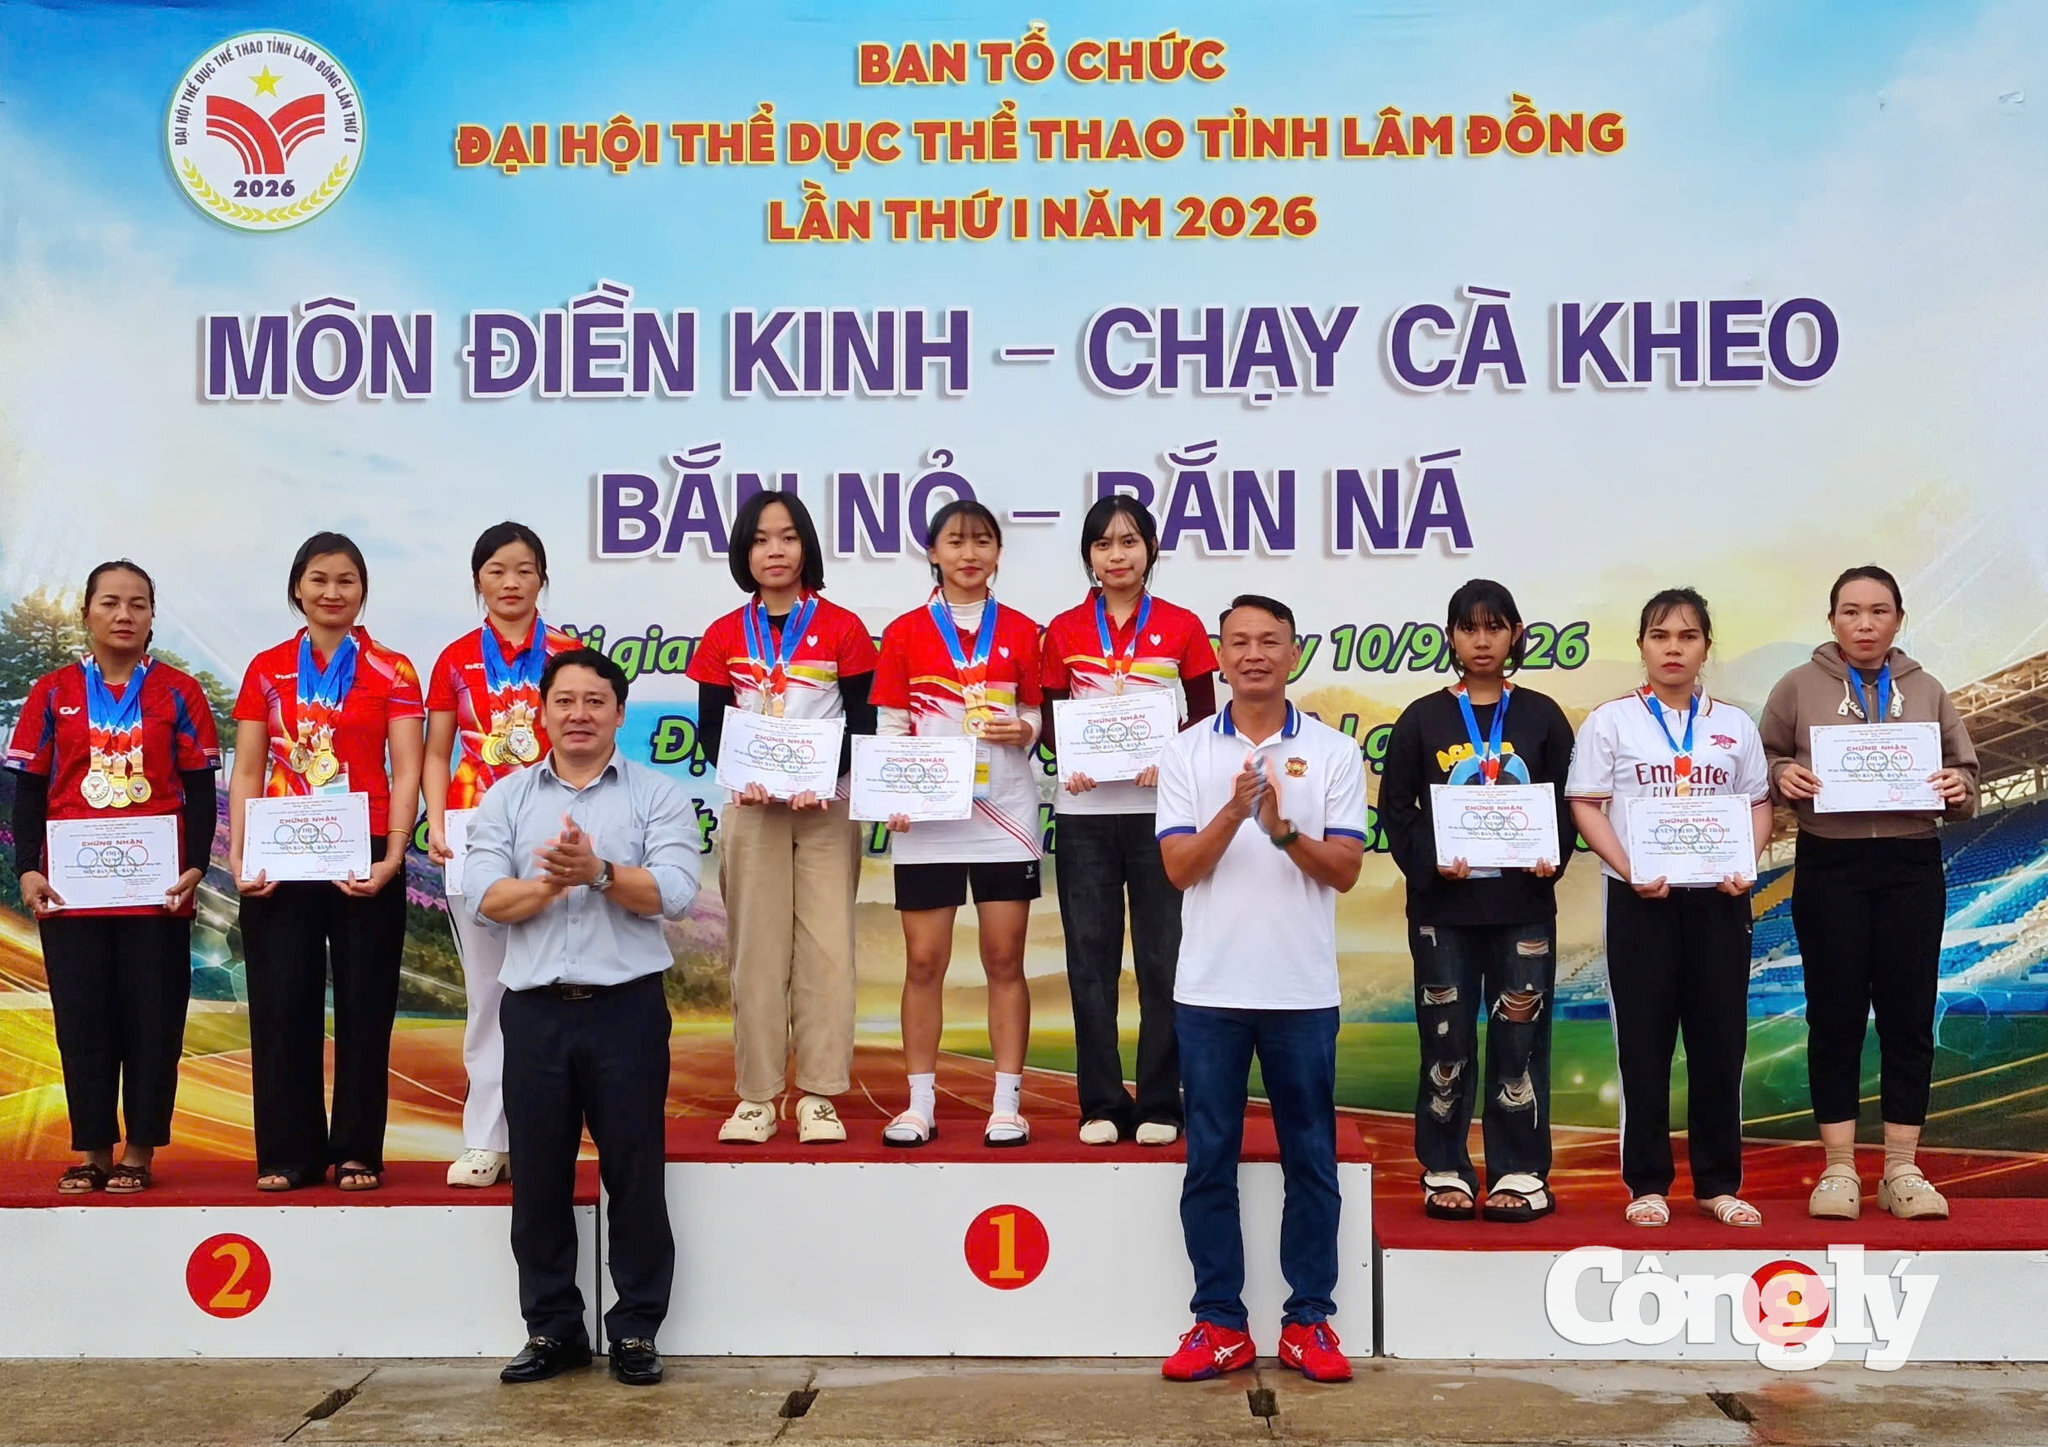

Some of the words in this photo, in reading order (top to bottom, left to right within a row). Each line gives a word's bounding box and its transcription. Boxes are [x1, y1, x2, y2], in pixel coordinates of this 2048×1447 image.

[194, 63, 216, 84] DỤC
[235, 41, 263, 57] THAO
[293, 45, 317, 66] LÂM
[861, 43, 967, 84] BAN
[980, 20, 1056, 83] TỔ
[1067, 31, 1226, 81] CHỨC
[175, 105, 192, 124] HỘI
[175, 127, 190, 145] ĐẠI
[457, 124, 547, 173] ĐẠI
[562, 115, 659, 173] HỘI
[673, 103, 776, 163] THỂ
[790, 121, 902, 171] DỤC
[914, 100, 1018, 161] THỂ
[1030, 119, 1185, 160] THAO
[1197, 107, 1329, 159] TỈNH
[1344, 107, 1454, 157] LÂM
[1466, 94, 1625, 156] ĐỒNG
[233, 179, 295, 197] 2026
[770, 180, 871, 241] LẦN
[885, 189, 1004, 240] THỨ
[1014, 197, 1029, 239] I
[1044, 189, 1162, 238] NĂM
[1178, 196, 1318, 238] 2026
[209, 296, 433, 397] MÔN
[467, 283, 695, 394] ĐIỀN
[734, 309, 969, 395] KINH
[1088, 306, 1360, 402] CHẠY
[1390, 286, 1527, 389] CÀ
[1561, 296, 1840, 385] KHEO
[1335, 447, 1474, 551] NÁ
[608, 624, 704, 684] gia
[1330, 621, 1590, 674] 10/9/26
[1634, 763, 1729, 785] Emates
[208, 1242, 252, 1309] 2
[989, 1212, 1025, 1279] 1
